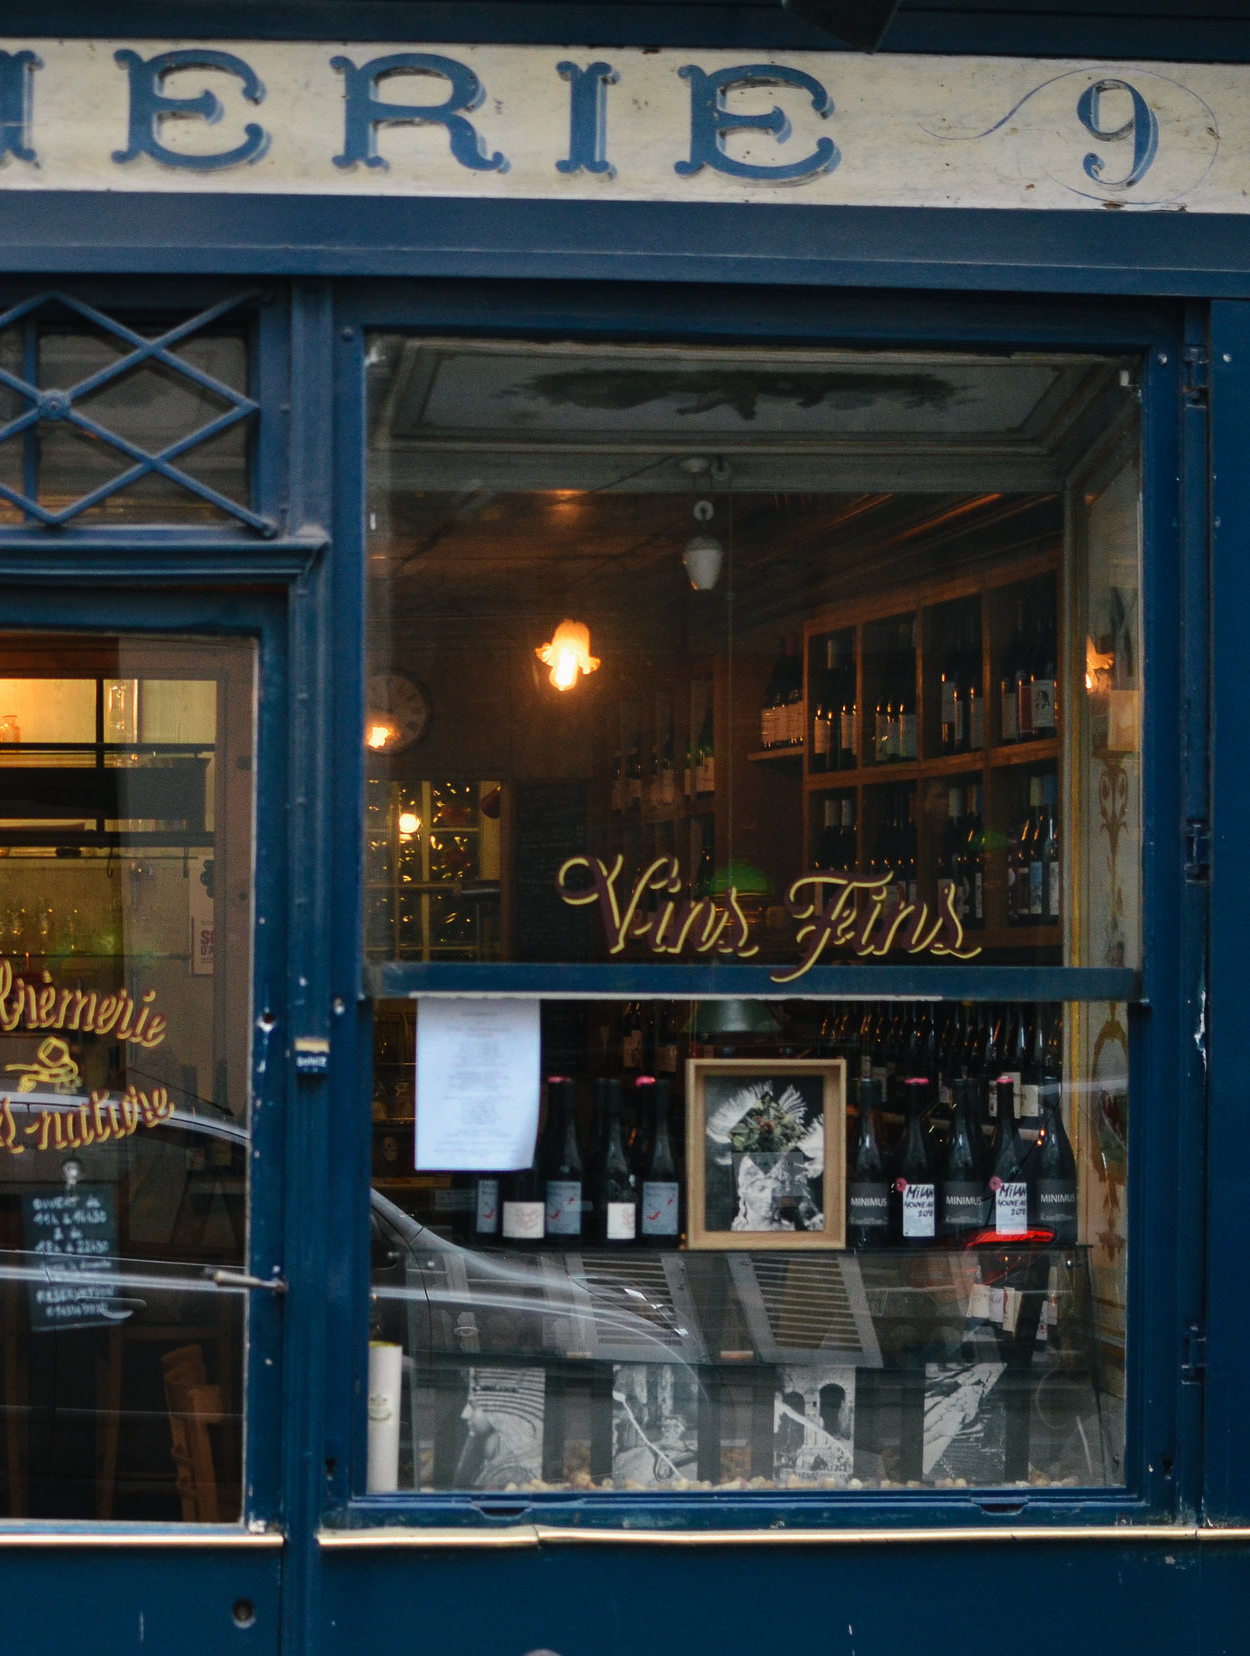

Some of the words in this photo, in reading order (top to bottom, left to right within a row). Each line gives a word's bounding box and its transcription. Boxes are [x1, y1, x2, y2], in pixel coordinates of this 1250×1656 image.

[1076, 78, 1158, 188] 9
[557, 854, 759, 957] Vins
[769, 869, 982, 983] Fins
[850, 1197, 888, 1208] MINIMUS
[945, 1195, 982, 1206] MINIMUS
[1040, 1193, 1076, 1204] MINIMUS
